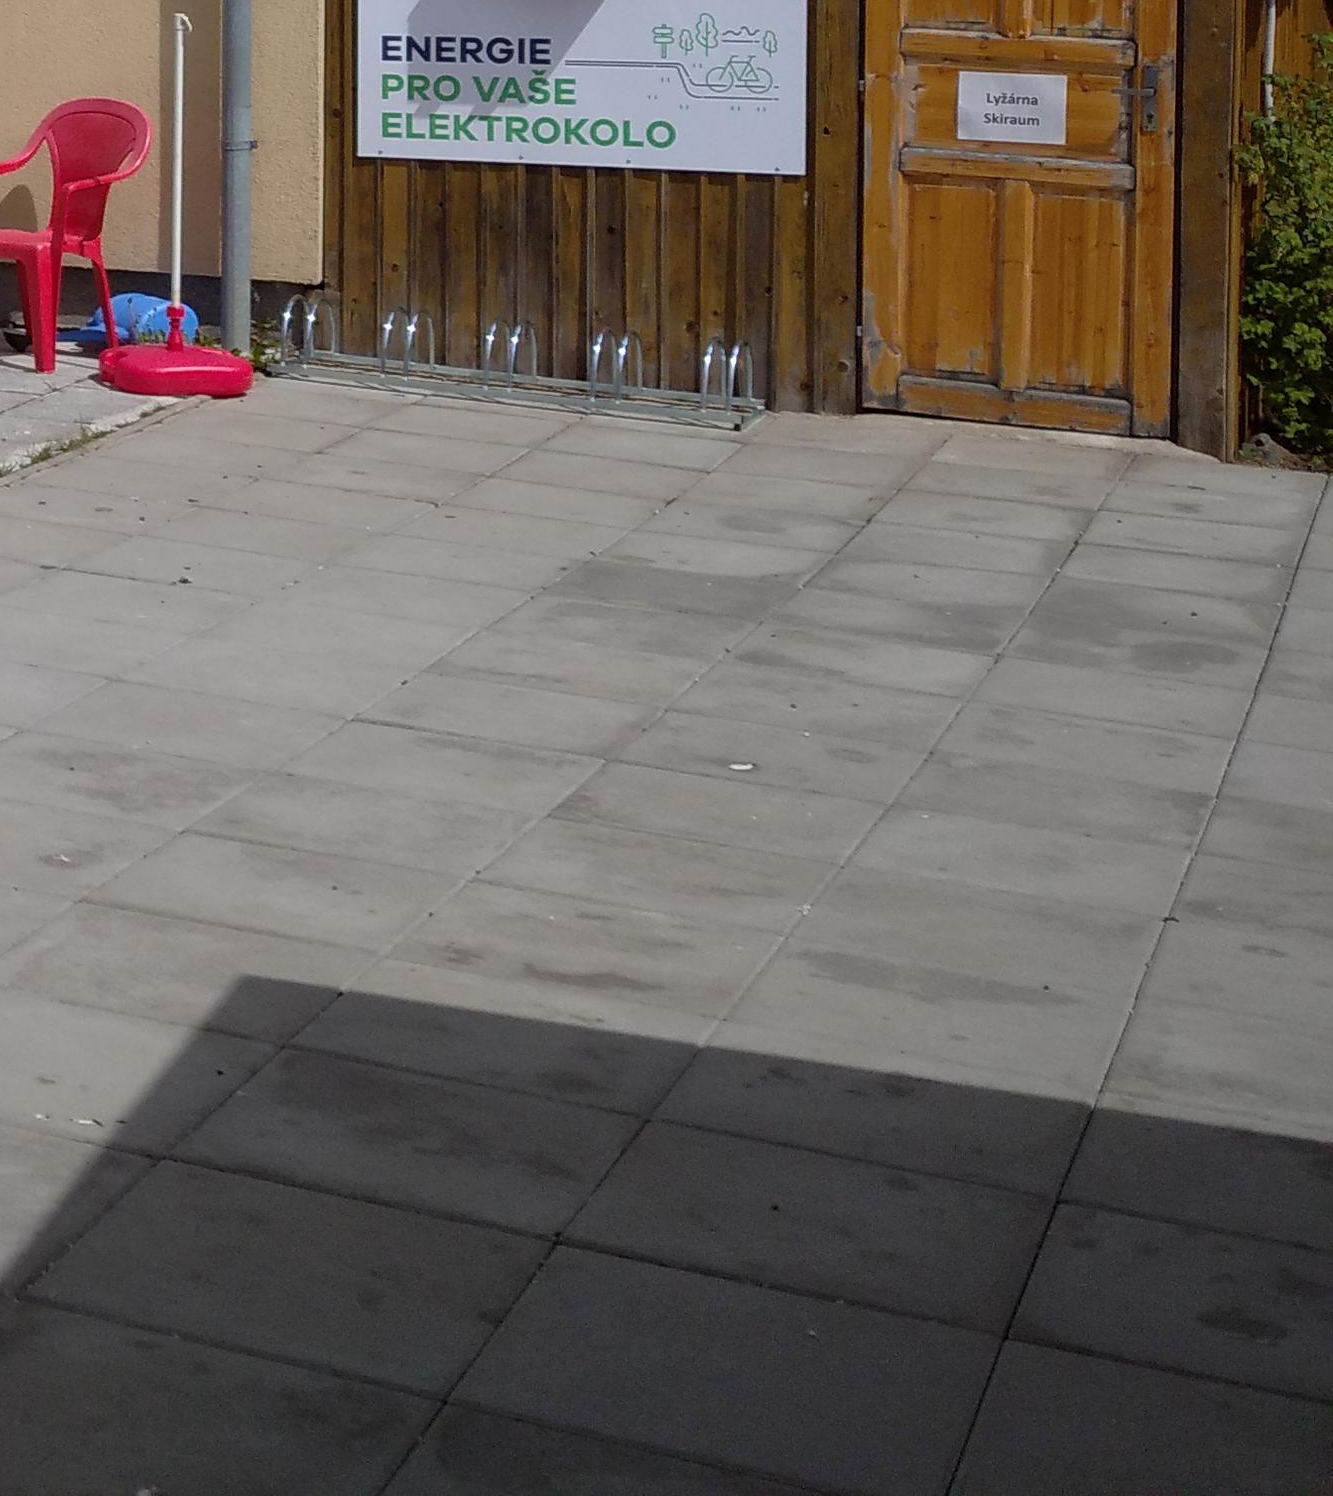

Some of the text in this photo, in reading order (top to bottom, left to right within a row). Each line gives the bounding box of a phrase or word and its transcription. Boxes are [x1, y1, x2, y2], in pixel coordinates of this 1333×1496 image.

[381, 35, 552, 65] ENERGIE
[381, 69, 577, 105] PRO VAŠE
[986, 92, 1039, 106] Lyžárna
[381, 112, 677, 149] ELEKTROKOLO
[983, 113, 1040, 126] Skiraum
